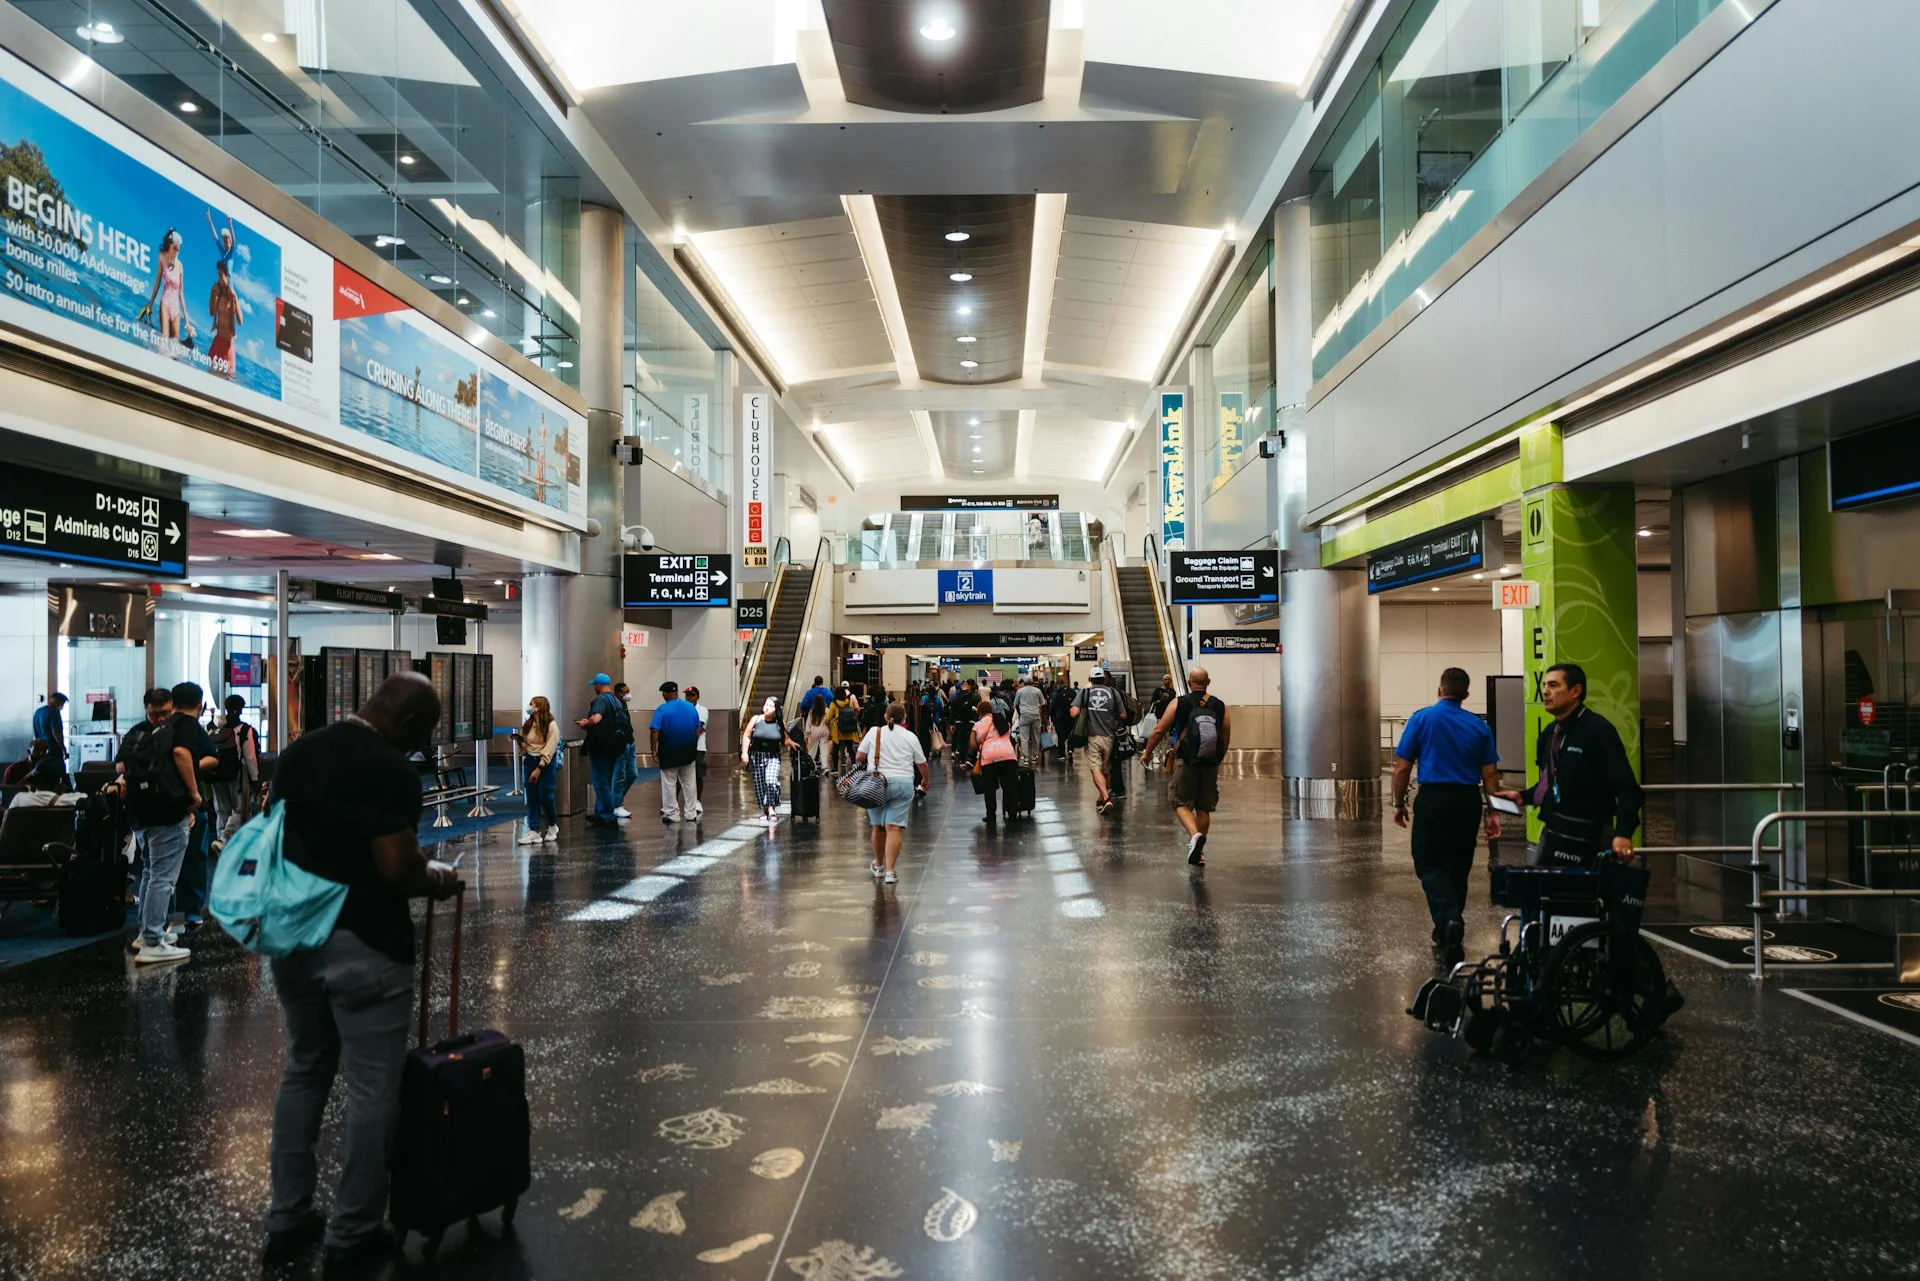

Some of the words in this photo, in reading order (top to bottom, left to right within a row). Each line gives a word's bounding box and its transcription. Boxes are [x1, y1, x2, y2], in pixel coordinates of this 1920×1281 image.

[7, 175, 94, 245] BEGINS
[98, 221, 151, 274] HERE
[6, 219, 35, 242] with
[37, 229, 79, 262] 50,000
[6, 237, 44, 270] bonus
[46, 258, 80, 285] miles.
[6, 269, 23, 291] $0
[25, 277, 54, 304] intro
[56, 294, 94, 320] annual
[96, 307, 114, 328] fee
[114, 314, 131, 334] for
[131, 322, 149, 341] the
[150, 330, 169, 349] first
[191, 348, 212, 367] then
[366, 358, 414, 400] CRUISING
[414, 383, 446, 415] ALONG
[446, 399, 471, 423] THERE
[485, 418, 510, 445] BEGINS
[510, 431, 526, 453] HERE
[751, 397, 760, 500] CLUBHOUSE
[1162, 406, 1184, 523] NewsLink
[96, 492, 140, 517] D1-D25
[54, 514, 110, 541] Admirals
[112, 525, 139, 545] Club
[751, 504, 760, 541] one
[6, 529, 21, 541] D12
[744, 547, 767, 556] KITCHEN
[1431, 539, 1448, 555] Terminal
[1451, 534, 1461, 549] EXIT
[128, 548, 139, 559] D15
[659, 556, 693, 569] EXIT
[744, 558, 749, 566] &
[754, 558, 767, 566] BAR
[1184, 557, 1216, 566] Baggage
[649, 573, 693, 583] Terminal
[961, 577, 970, 590] 2
[1203, 575, 1239, 584] Transport
[336, 588, 355, 600] FLIGHT
[355, 591, 387, 604] INFORMATION
[650, 589, 659, 599] F,
[661, 589, 672, 599] G,
[675, 589, 685, 599] H,
[687, 589, 693, 598] J
[955, 591, 986, 601] skytrain
[1502, 585, 1529, 605] EXIT
[740, 607, 763, 618] D25
[628, 633, 645, 645] EXIT
[739, 631, 750, 640] EXIT
[1554, 850, 1583, 864] envoy
[1551, 923, 1565, 938] AA
